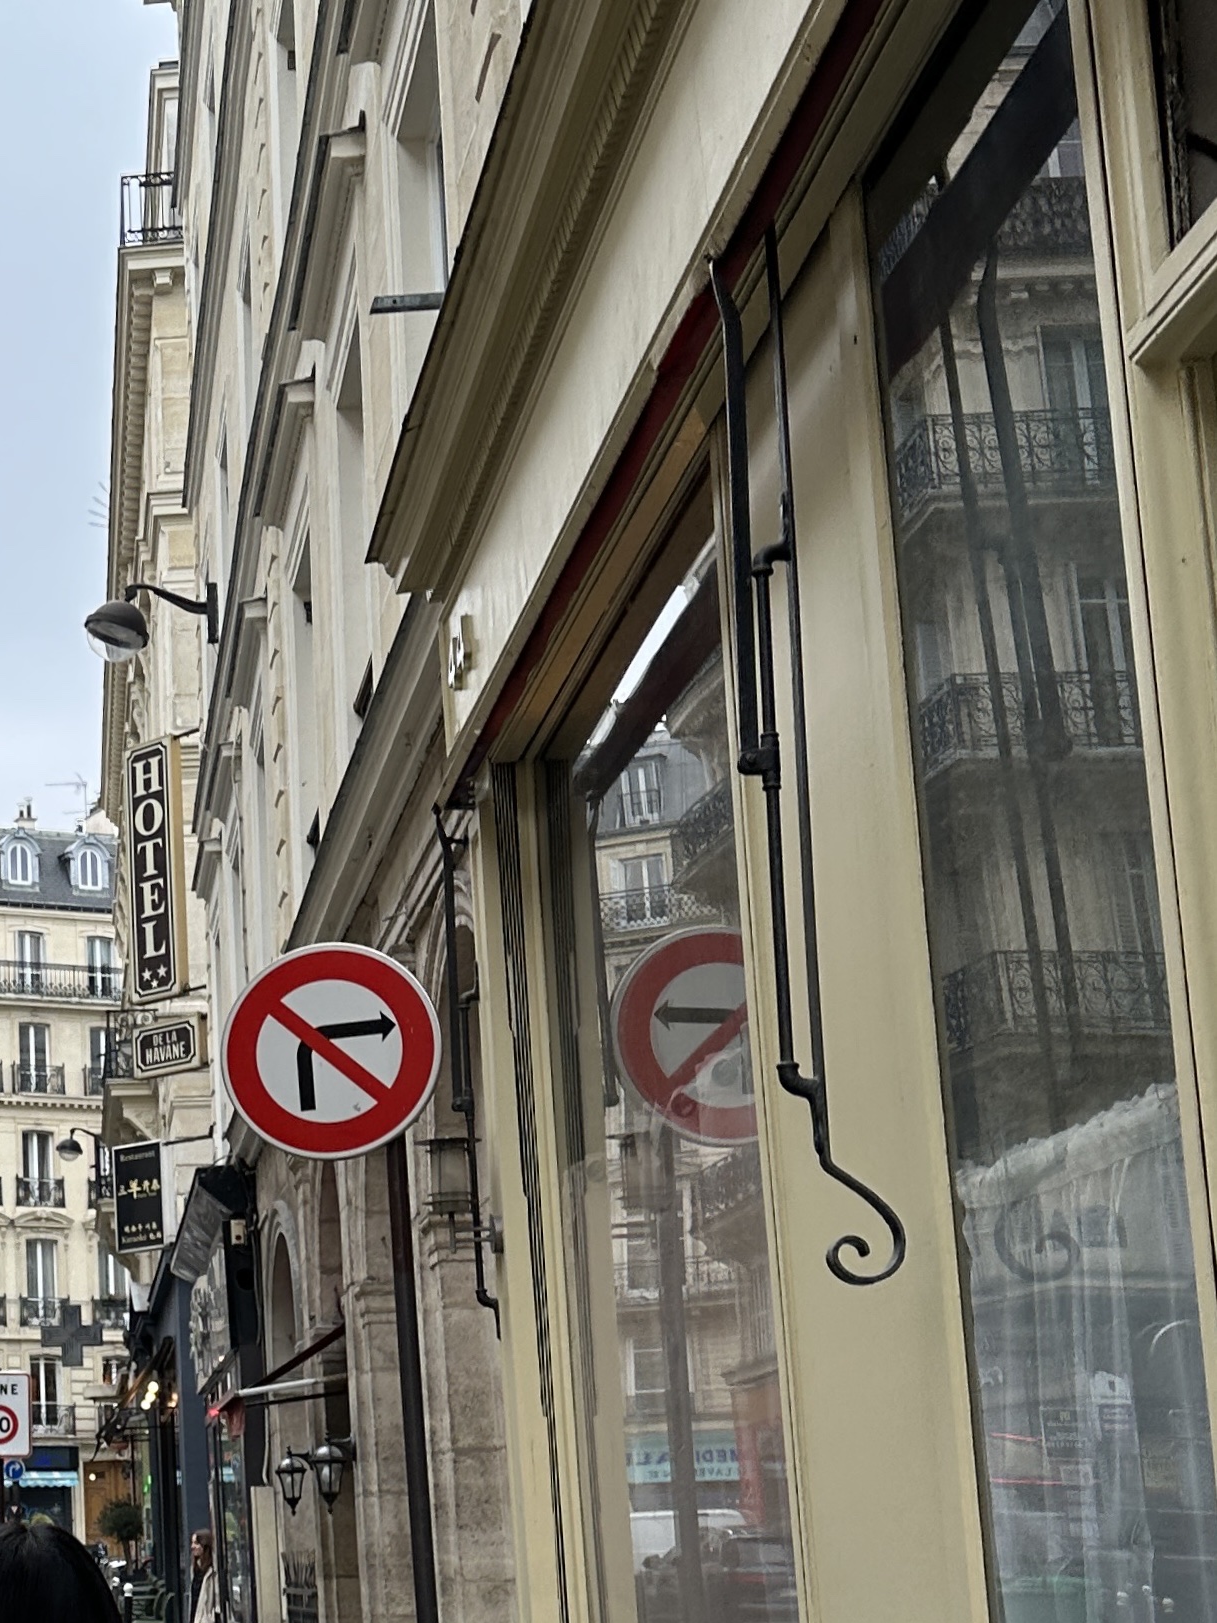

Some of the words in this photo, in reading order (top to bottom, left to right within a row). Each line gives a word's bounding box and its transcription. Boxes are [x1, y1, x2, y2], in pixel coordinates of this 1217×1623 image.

[132, 754, 167, 960] HOTEL
[152, 1033, 167, 1047] DE
[168, 1031, 178, 1044] LA
[145, 1041, 187, 1064] HAVANE
